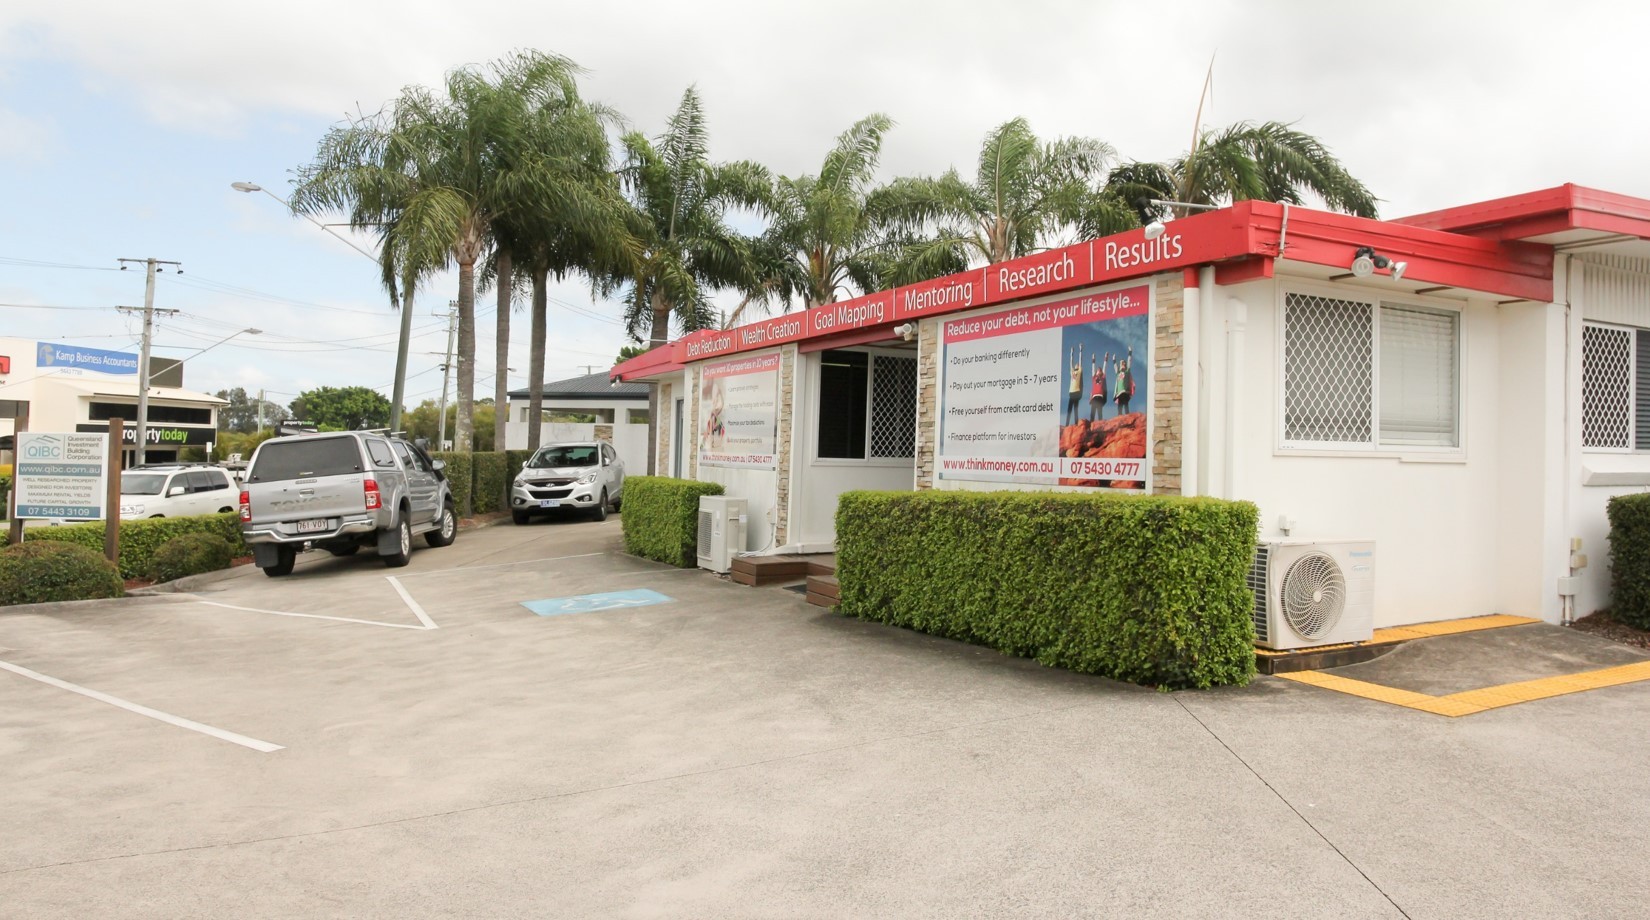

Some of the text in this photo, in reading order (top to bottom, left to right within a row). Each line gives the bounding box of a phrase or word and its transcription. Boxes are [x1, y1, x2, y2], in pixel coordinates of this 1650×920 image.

[687, 234, 1183, 357] Debt Reduction Wealth Creation Goal Mapping Mentoring Research Results
[947, 293, 1140, 337] Reduce your debt, not your lifestyle...
[56, 350, 137, 368] Kamp Business Accountants
[953, 348, 1030, 366] Do your banking differently
[952, 381, 963, 392] Pay
[963, 381, 973, 390] out
[973, 380, 987, 391] your
[987, 378, 1016, 390] mortgage
[1017, 377, 1023, 386] in
[1023, 376, 1029, 385] 5
[1033, 375, 1038, 384] 7
[1039, 375, 1058, 386] years
[951, 402, 1054, 417] Free yourself from credit card debt
[122, 428, 188, 443] rortytoday
[951, 432, 1037, 443] Finance platform for investors
[28, 446, 61, 458] QIBC
[67, 448, 91, 456] Building
[20, 465, 100, 475] www.qibc.com.au
[943, 458, 1140, 476] www.thinkmoney.com.au 07 5430 4777
[270, 494, 345, 512] TOYOTA
[28, 507, 90, 516] 07 5443 3109
